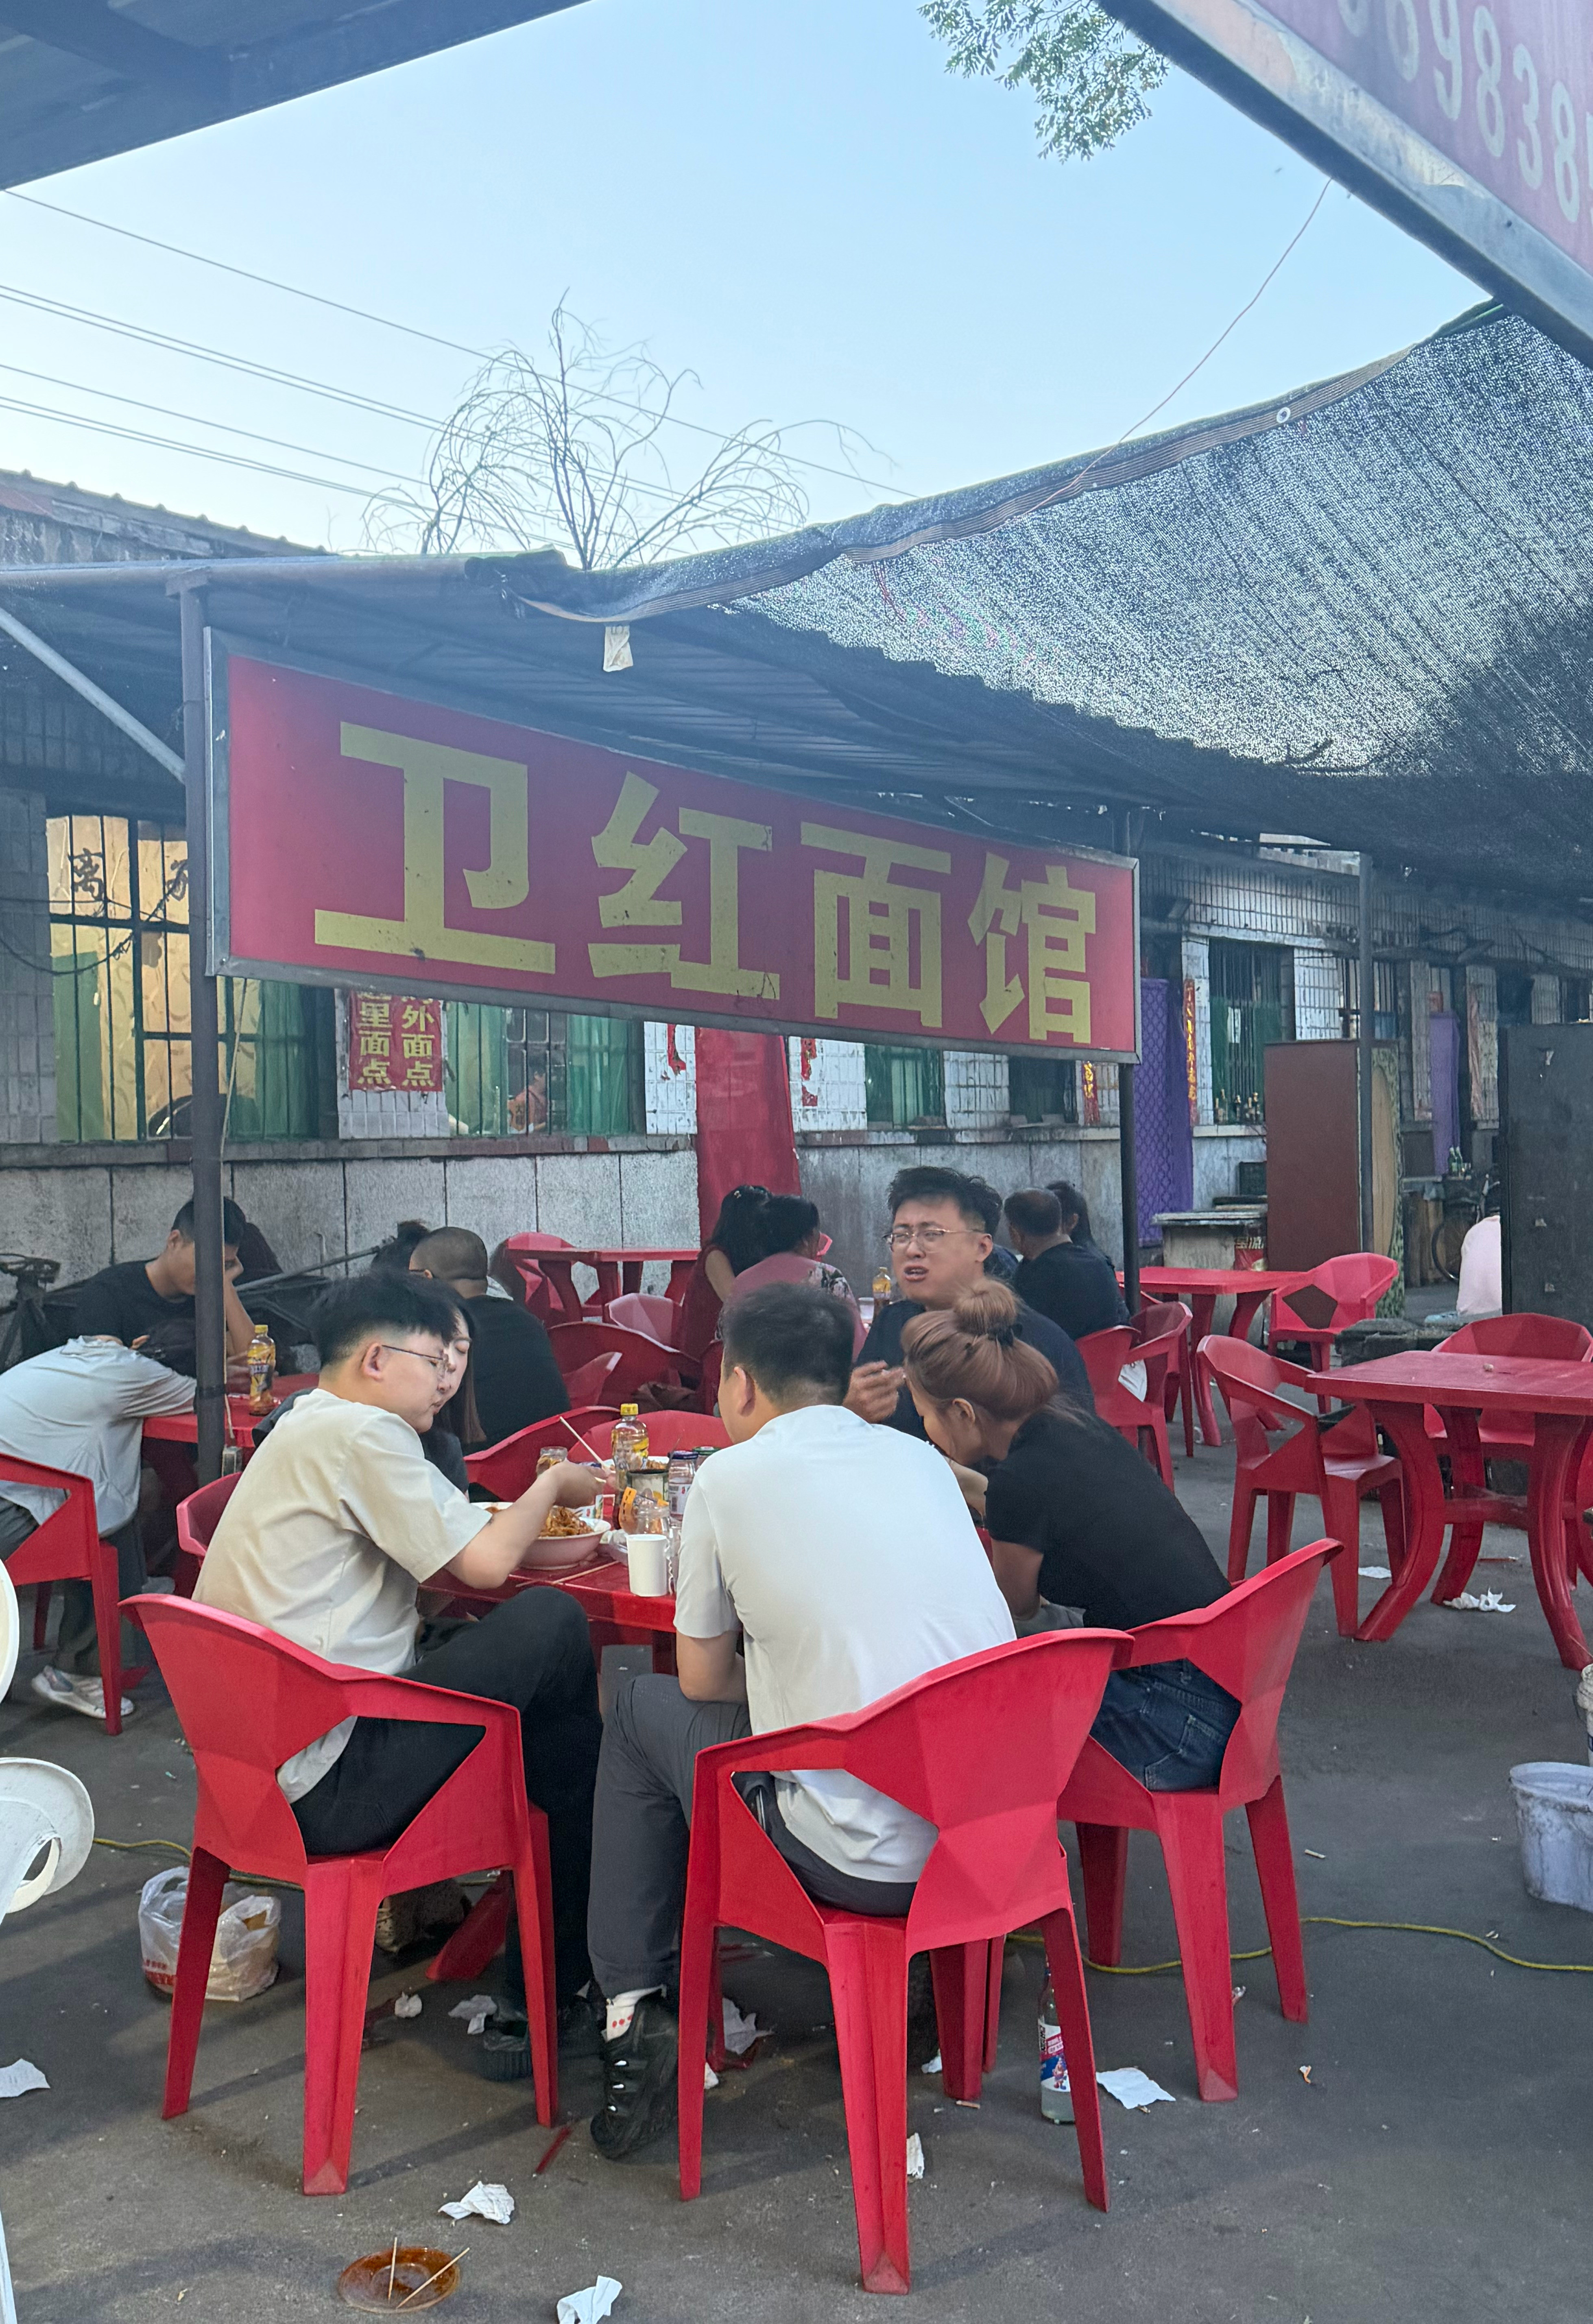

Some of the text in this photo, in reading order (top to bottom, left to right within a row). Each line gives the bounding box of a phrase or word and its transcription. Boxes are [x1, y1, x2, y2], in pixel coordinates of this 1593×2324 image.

[315, 722, 1095, 1044] 卫红面馆
[401, 996, 434, 1088] 外面点
